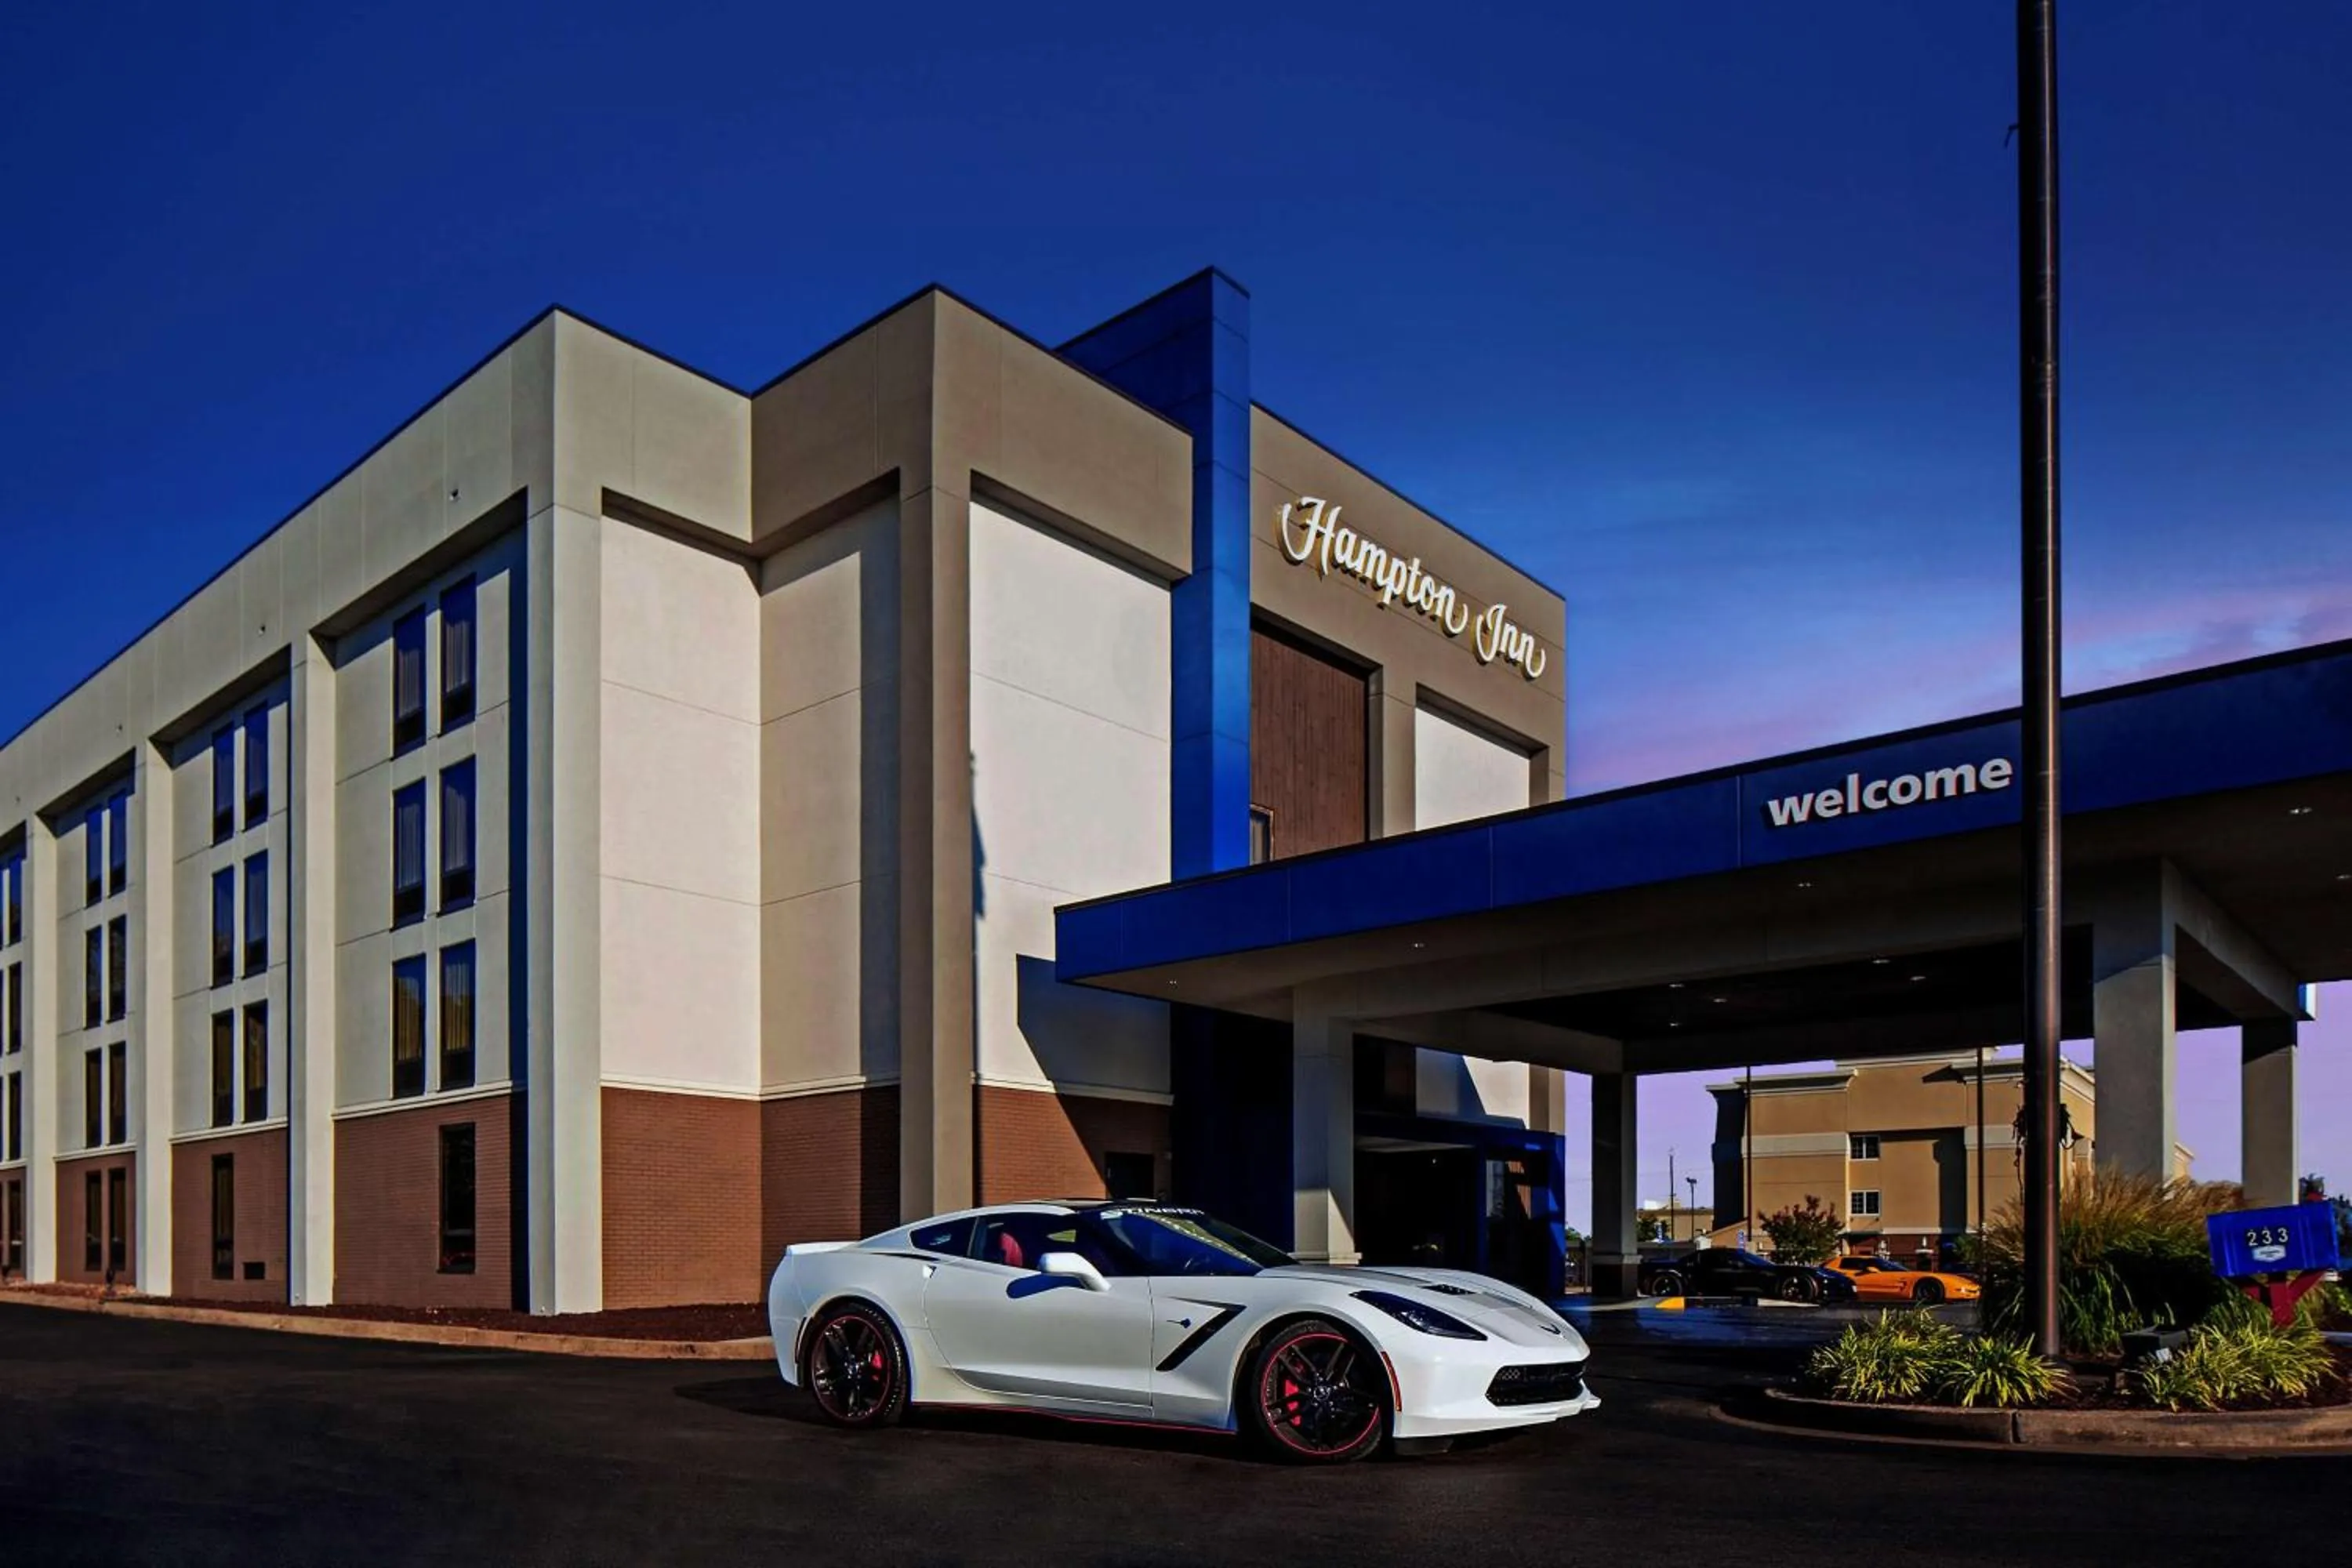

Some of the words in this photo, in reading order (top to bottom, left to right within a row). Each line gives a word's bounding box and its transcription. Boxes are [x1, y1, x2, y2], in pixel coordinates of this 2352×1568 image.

[1281, 495, 1469, 635] Hampton
[1475, 603, 1547, 679] Inn
[1767, 757, 2013, 826] welcome
[2247, 1227, 2288, 1247] 233
